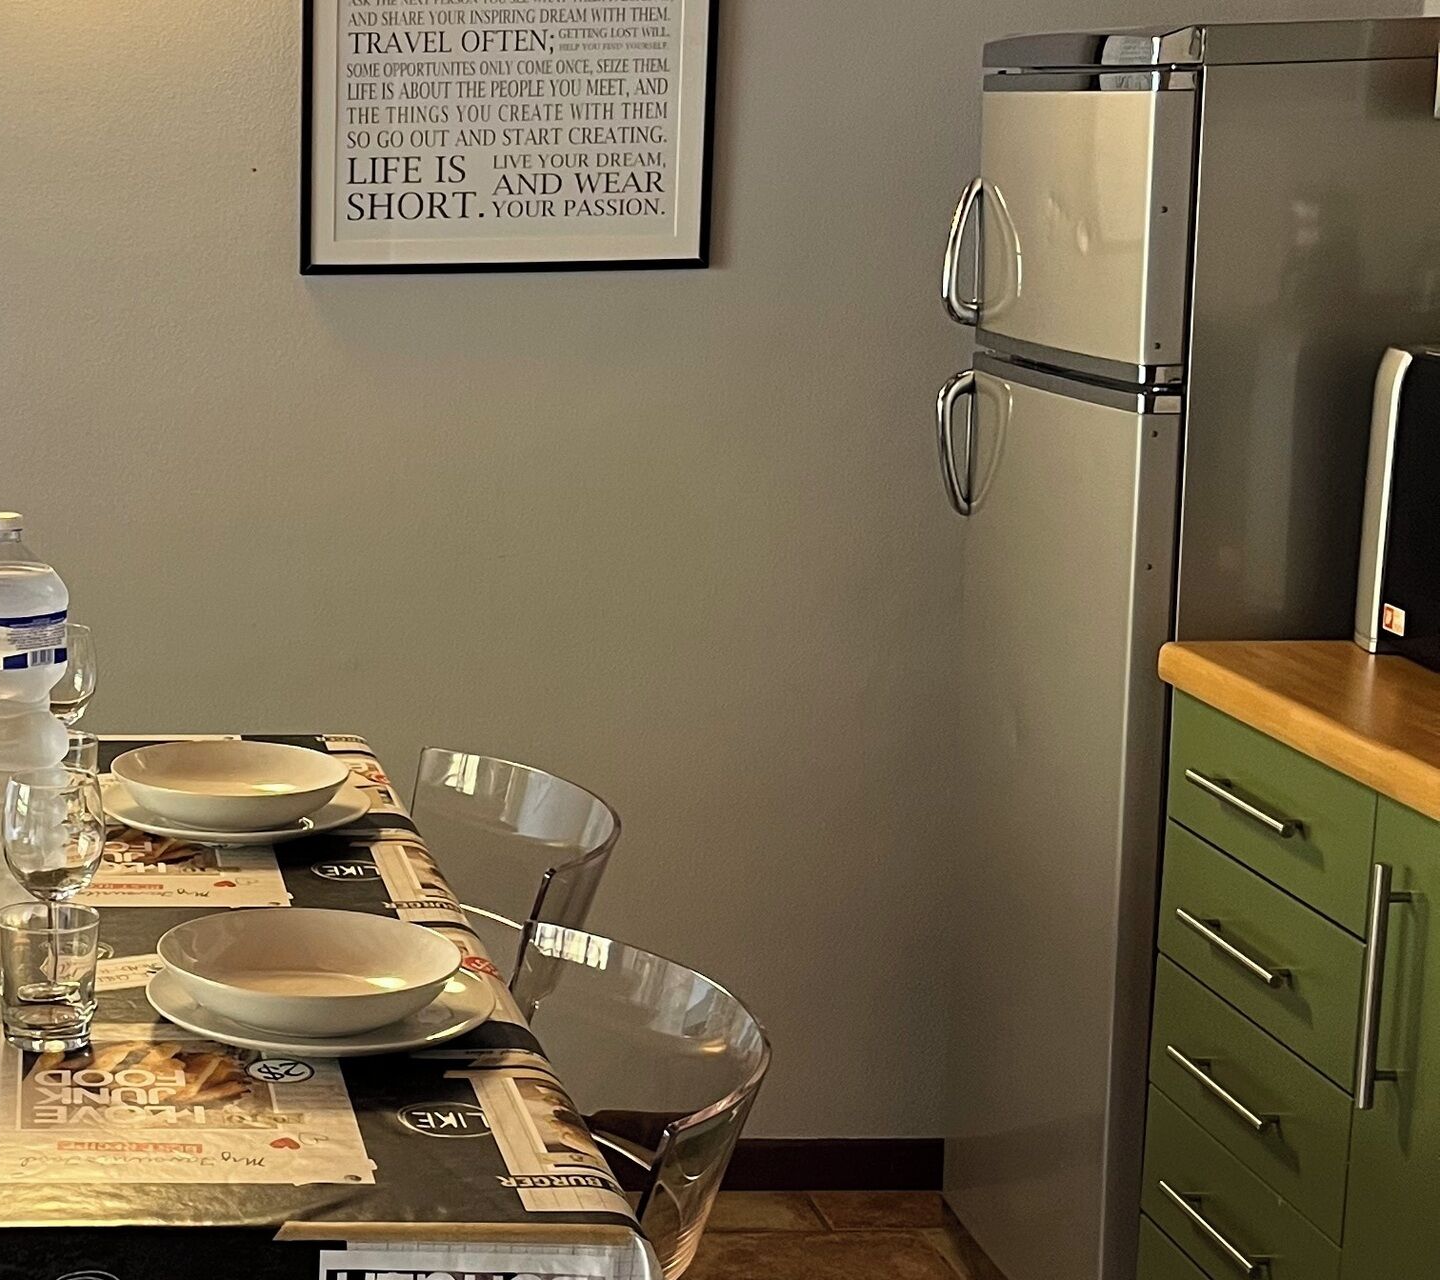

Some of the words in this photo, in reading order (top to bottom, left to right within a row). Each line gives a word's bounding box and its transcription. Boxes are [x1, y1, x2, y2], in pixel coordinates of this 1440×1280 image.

[347, 11, 378, 27] AND
[380, 11, 425, 27] SHARE
[428, 10, 466, 26] YOUR
[468, 9, 536, 25] INSPIRING
[539, 8, 588, 24] DREAM
[590, 7, 627, 23] WITH
[347, 30, 453, 55] TRAVEL
[460, 29, 556, 55] OFTEN;
[557, 27, 609, 40] GETTING
[609, 27, 639, 39] LOST
[346, 62, 381, 79] SOME
[479, 60, 512, 76] ONLY
[516, 59, 553, 76] COME
[555, 59, 594, 75] ONCE,
[596, 58, 630, 74] SEIZE
[346, 82, 377, 101] LIFE
[381, 82, 395, 101] IS
[399, 81, 452, 100] ABOUT
[456, 80, 486, 100] THE
[490, 79, 546, 99] PEOPLE
[549, 78, 582, 98] YOU
[585, 77, 631, 98] MEET,
[634, 77, 669, 97] AND
[345, 106, 381, 125] THE
[384, 105, 450, 124] THINGS
[456, 104, 492, 123] YOU
[497, 103, 564, 123] CREATE
[569, 102, 616, 122] WITH
[620, 101, 668, 121] THEM
[346, 130, 371, 149] SO
[376, 130, 405, 149] GO
[409, 129, 451, 148] OUT
[455, 128, 497, 147] AND
[501, 127, 564, 147] START
[567, 126, 668, 146] CREATING.
[345, 155, 423, 185] LIFE
[434, 155, 467, 184] IS
[492, 153, 533, 170] LIVE
[537, 152, 589, 169] YOUR
[596, 152, 667, 169] DREAM,
[491, 173, 564, 196] AND
[574, 171, 666, 195] WEAR
[346, 190, 485, 221] SHORT.
[491, 199, 556, 219] YOUR
[563, 198, 666, 218] PASSION.
[321, 864, 381, 877] LIKE
[35, 1069, 186, 1087] FOOD
[257, 1060, 305, 1081] 2$
[35, 1086, 177, 1105] JUNK
[34, 1104, 174, 1125] LOVE
[411, 1111, 491, 1130] LIKE
[495, 1174, 603, 1191] BURGER
